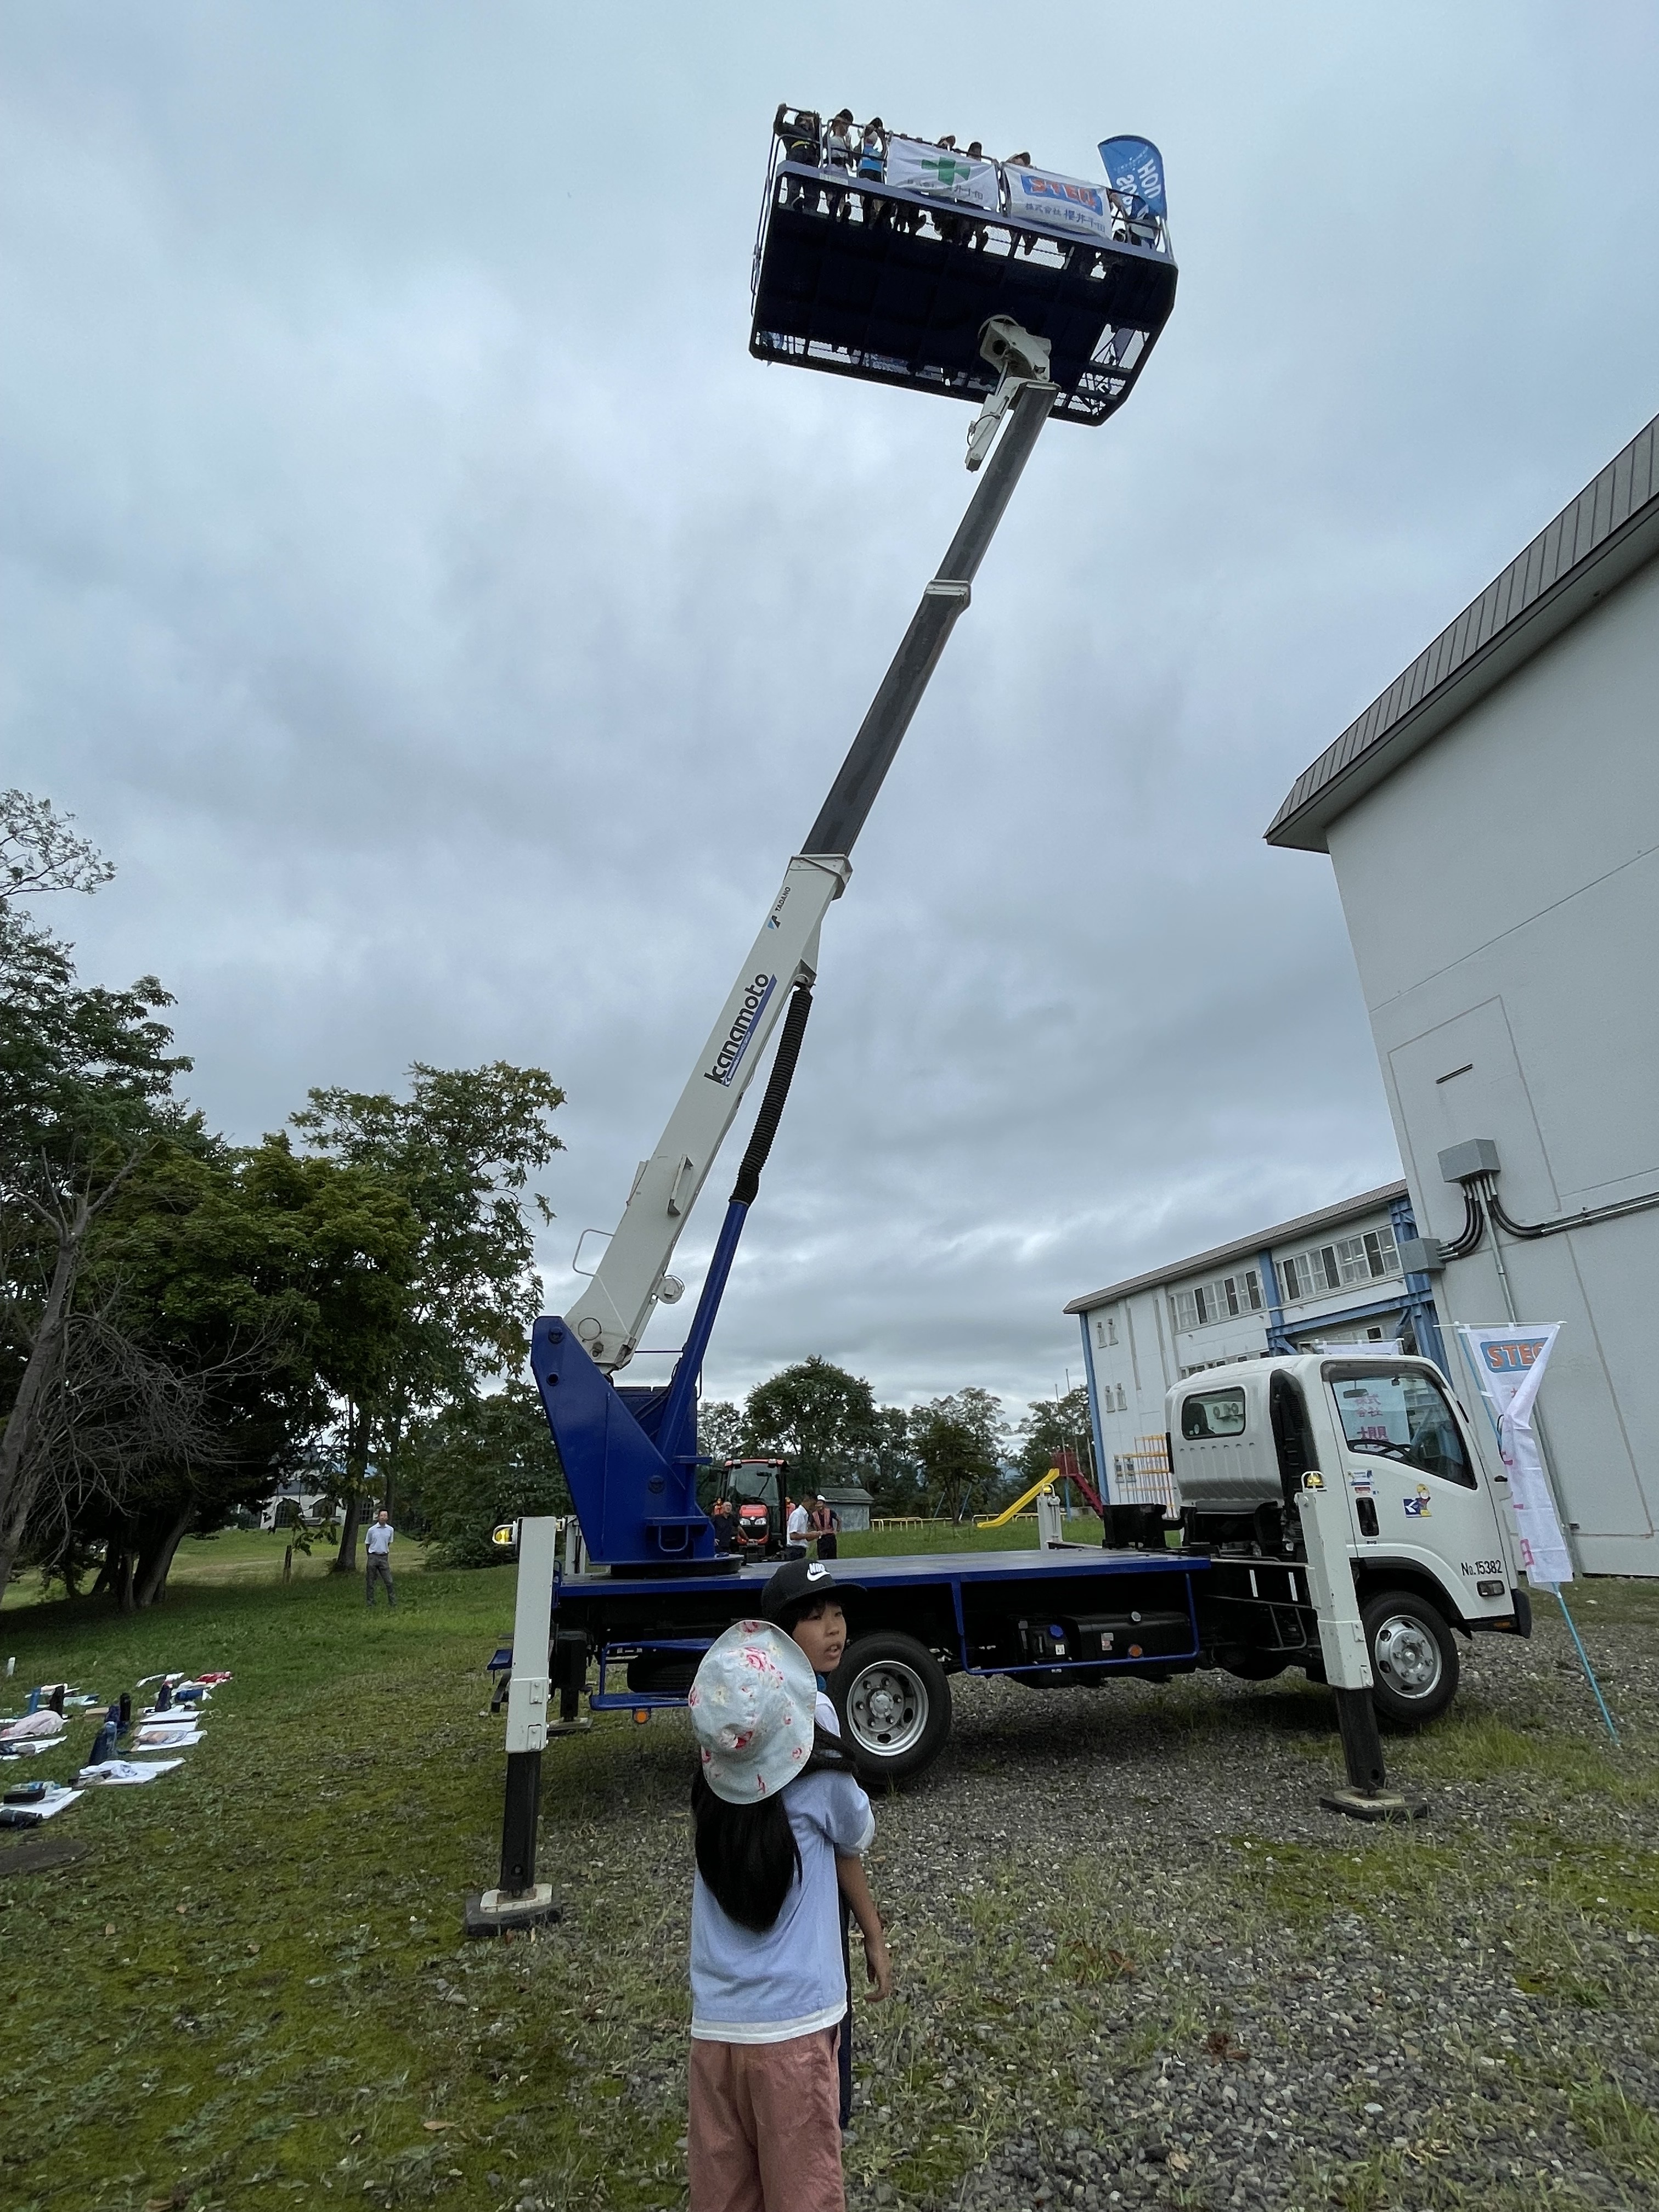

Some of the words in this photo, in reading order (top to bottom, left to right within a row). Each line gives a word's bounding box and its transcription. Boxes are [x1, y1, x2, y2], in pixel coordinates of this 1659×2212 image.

[775, 887, 791, 911] TADANO
[703, 974, 769, 1084] kanamoto
[1461, 1560, 1503, 1576] No.15382
